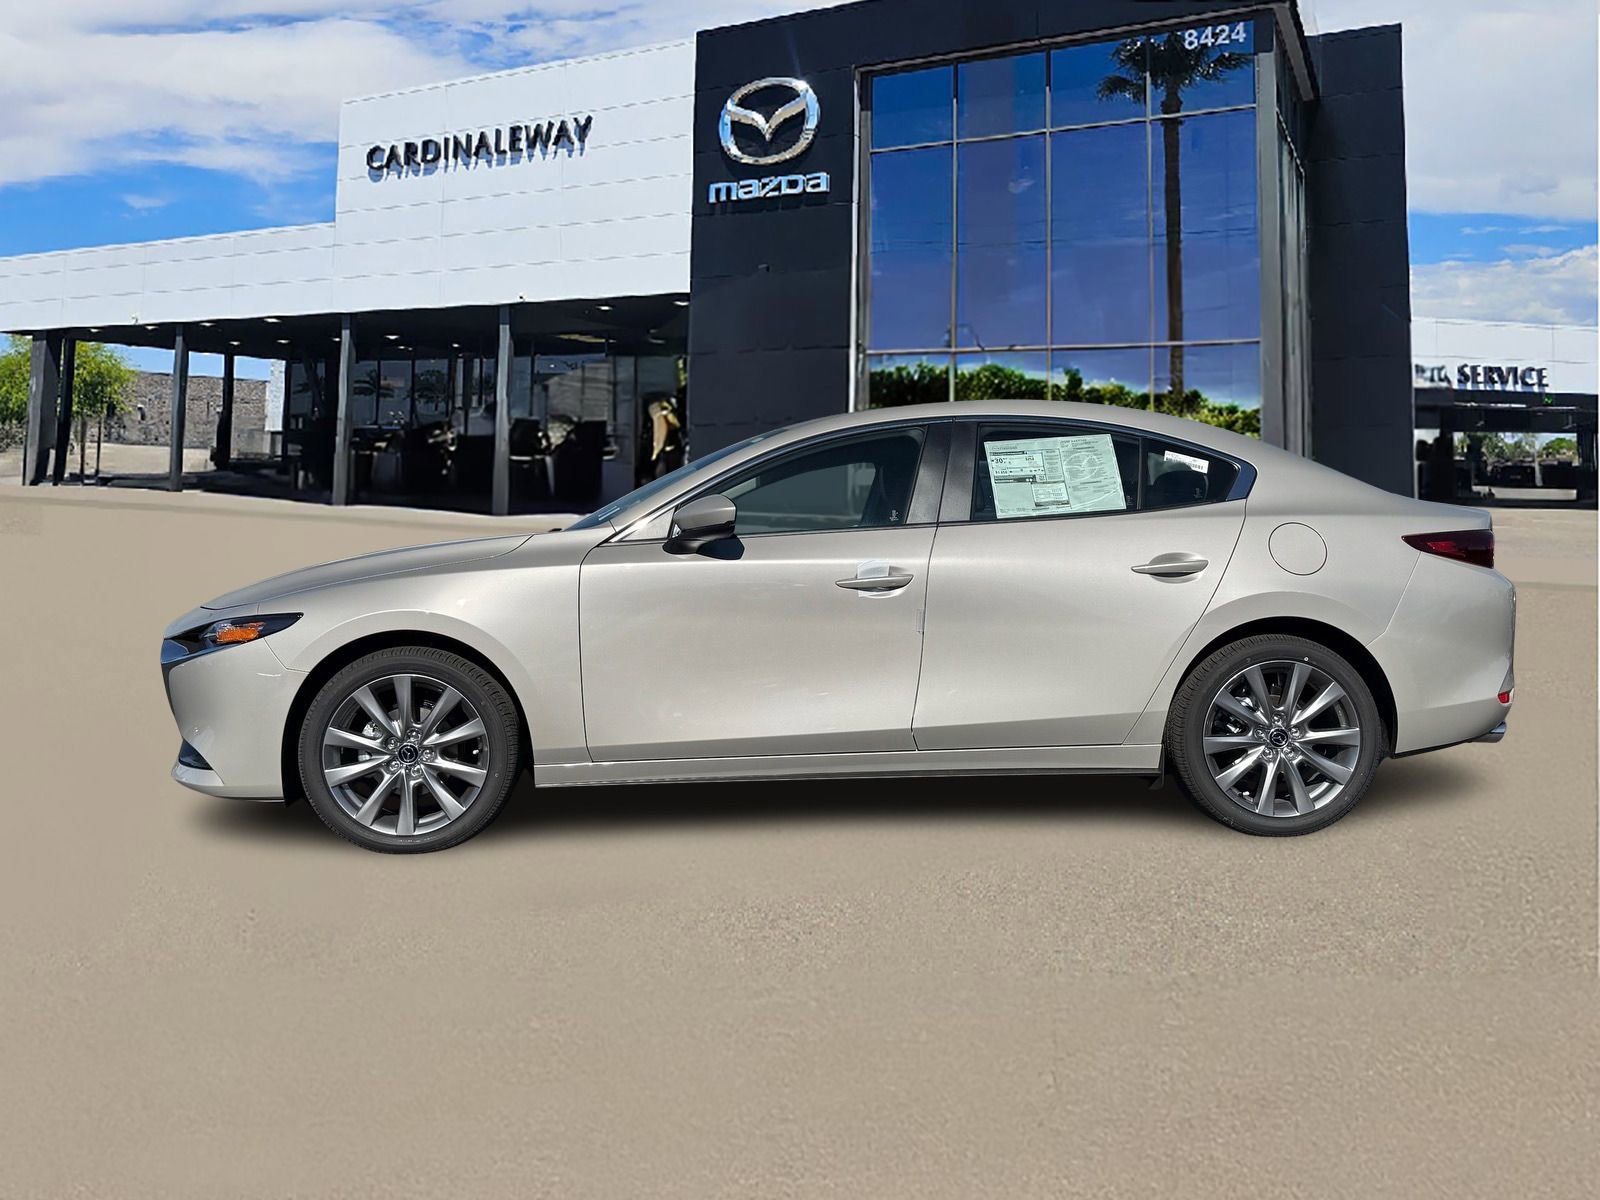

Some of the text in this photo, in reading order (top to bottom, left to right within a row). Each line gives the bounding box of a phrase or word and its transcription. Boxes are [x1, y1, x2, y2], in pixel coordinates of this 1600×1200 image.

[1184, 22, 1246, 50] 8424
[366, 114, 594, 171] CARDINALEWAY
[708, 172, 830, 203] mazda
[1457, 363, 1549, 388] SERVICE
